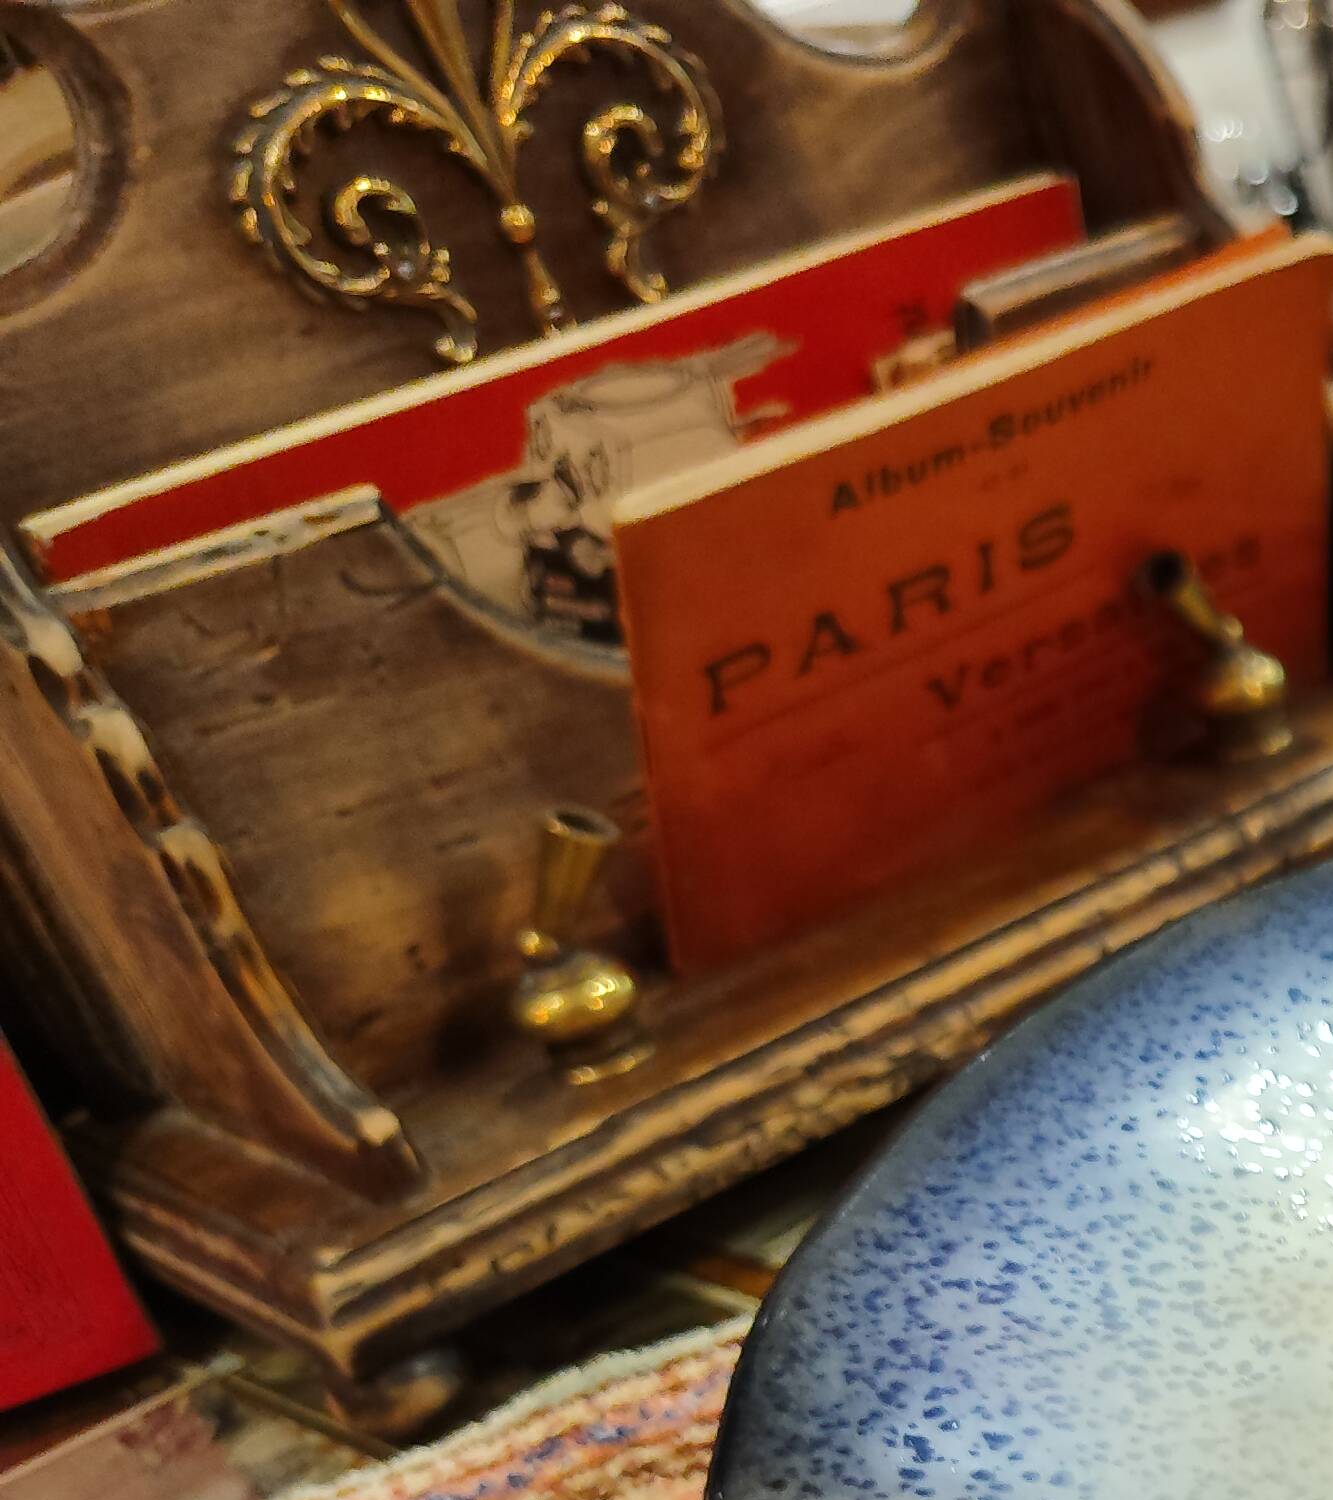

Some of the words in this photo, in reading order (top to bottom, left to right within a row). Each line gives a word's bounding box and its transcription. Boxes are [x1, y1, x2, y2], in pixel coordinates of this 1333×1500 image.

[830, 357, 1154, 515] Album-Souvenir
[704, 503, 1075, 716] PARIS
[926, 536, 1262, 710] Versaes
